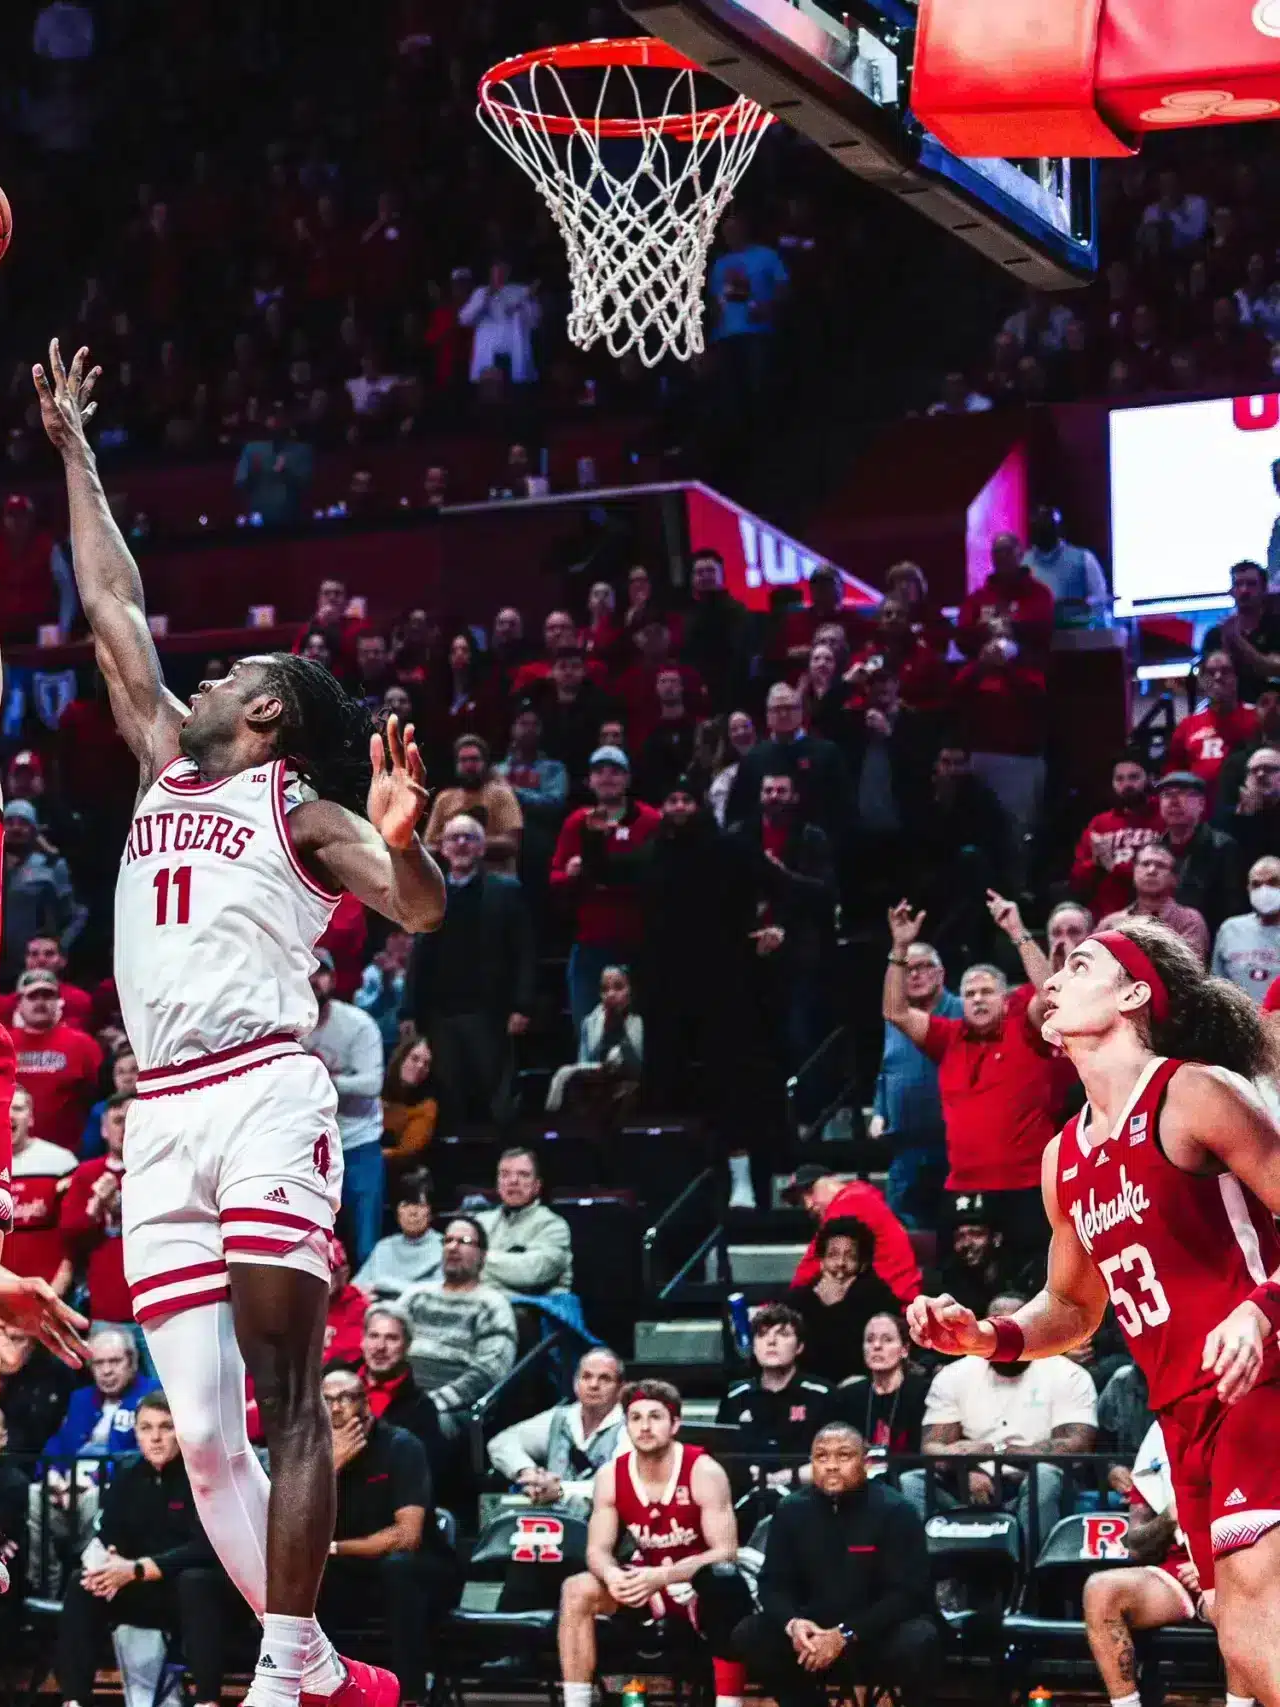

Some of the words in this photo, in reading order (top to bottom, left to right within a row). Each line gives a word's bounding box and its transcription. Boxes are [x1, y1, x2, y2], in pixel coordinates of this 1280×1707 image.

[127, 813, 255, 866] RUTGERS
[153, 866, 192, 926] 11
[263, 1195, 290, 1206] adidas
[1069, 1164, 1150, 1256] Nebraska
[1098, 1243, 1171, 1338] 53
[1079, 1516, 1129, 1560] R
